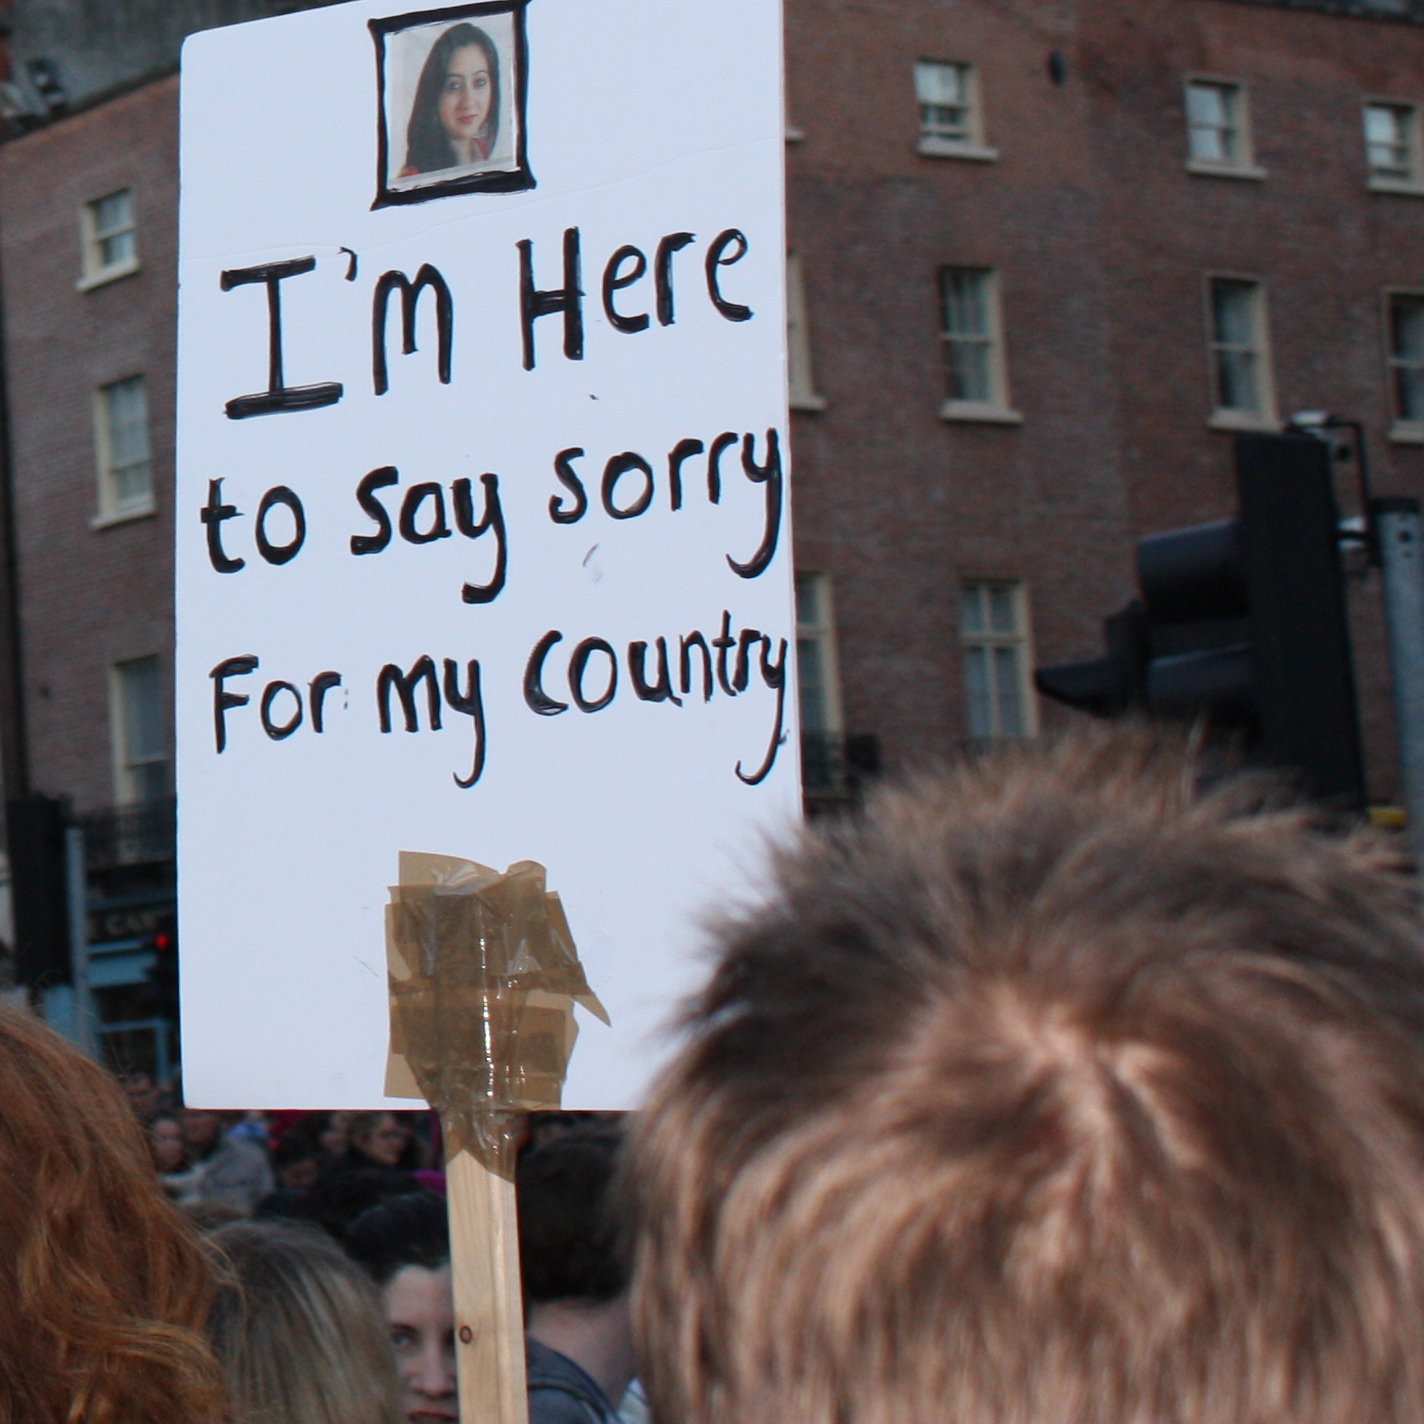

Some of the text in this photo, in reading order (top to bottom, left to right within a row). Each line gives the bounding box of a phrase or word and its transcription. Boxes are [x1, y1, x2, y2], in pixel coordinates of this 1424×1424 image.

[517, 227, 753, 371] Here
[201, 429, 782, 604] to say sorry
[210, 656, 341, 754] For
[524, 611, 787, 785] country
